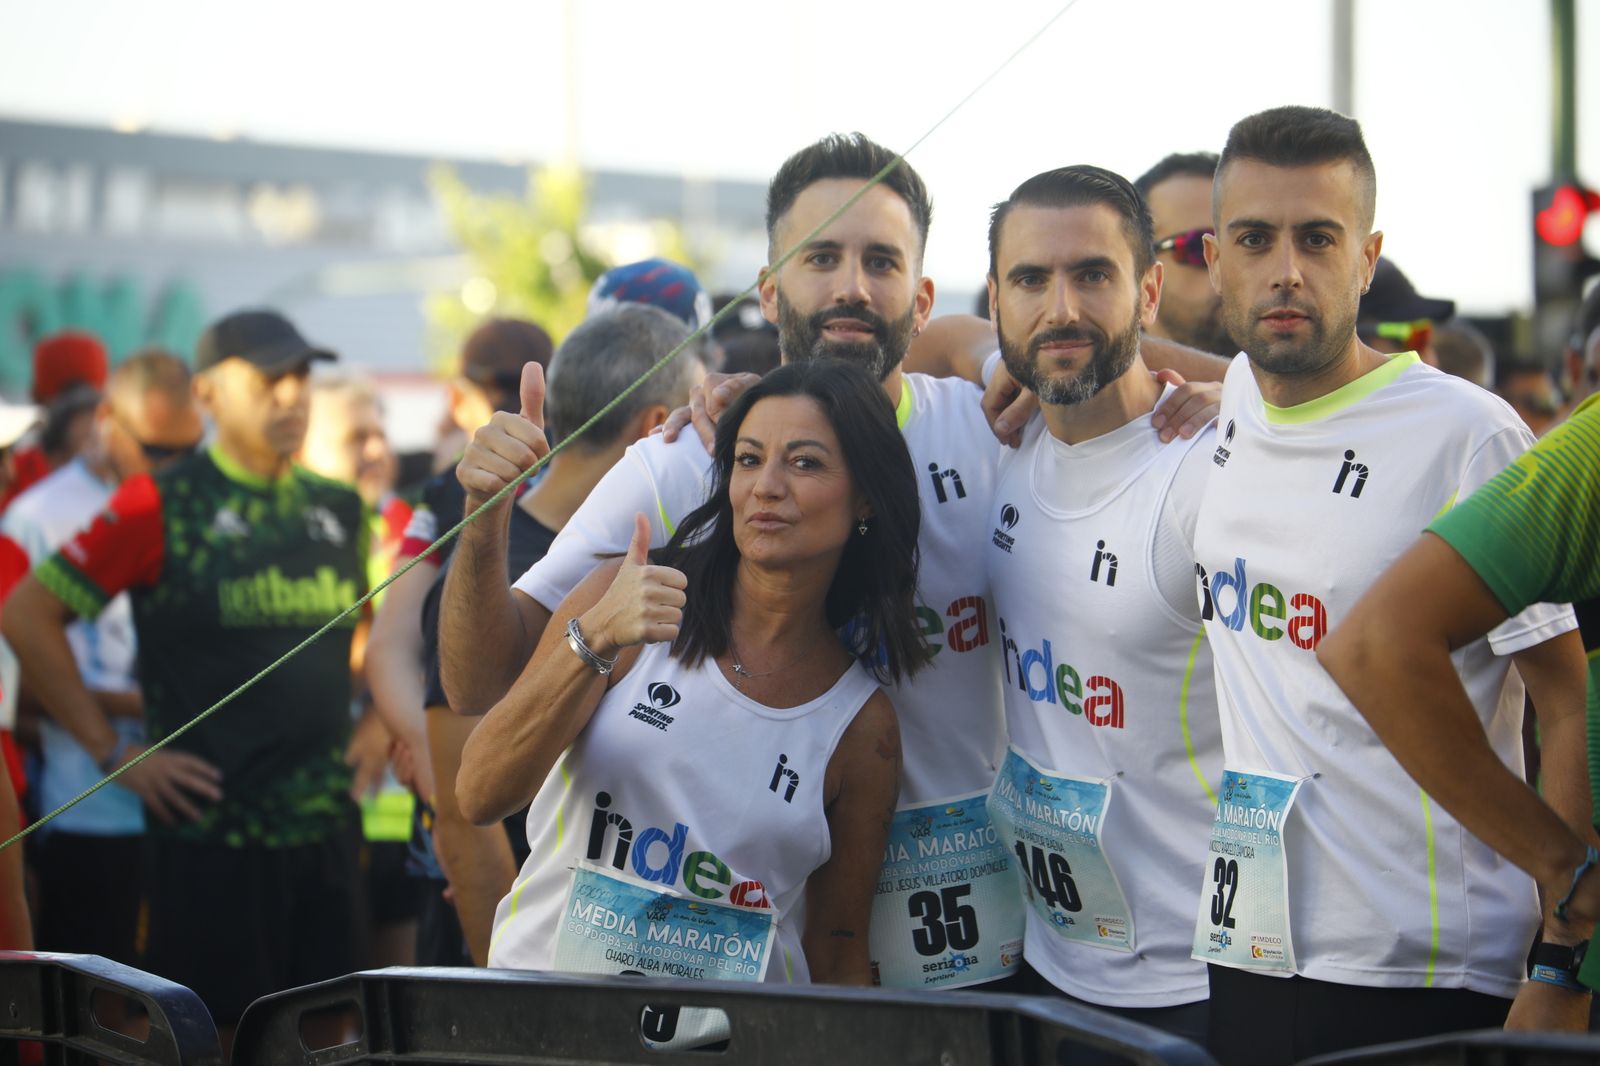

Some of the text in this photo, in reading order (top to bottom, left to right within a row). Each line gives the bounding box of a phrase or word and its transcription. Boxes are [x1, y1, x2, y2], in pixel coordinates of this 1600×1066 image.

[928, 462, 967, 504] in
[1332, 449, 1369, 499] in
[1090, 539, 1118, 587] in
[1194, 557, 1327, 652] ndea
[999, 617, 1125, 729] indea
[634, 702, 674, 724] SPORTING
[768, 753, 800, 804] in
[918, 820, 998, 859] MARATÓ
[1026, 796, 1097, 834] MARATÓN
[1223, 803, 1280, 831] MARATÓN
[1248, 832, 1262, 844] DEL
[1265, 833, 1280, 846] RÍO
[586, 791, 772, 909] indea
[1014, 840, 1082, 913] 146
[1210, 857, 1239, 929] 32
[571, 899, 762, 962] MEDIA MARATÓN
[907, 883, 980, 956] 35
[605, 948, 705, 981] CHARO ALBA MORALES
[708, 957, 731, 972] DEL
[734, 960, 758, 976] RÍO
